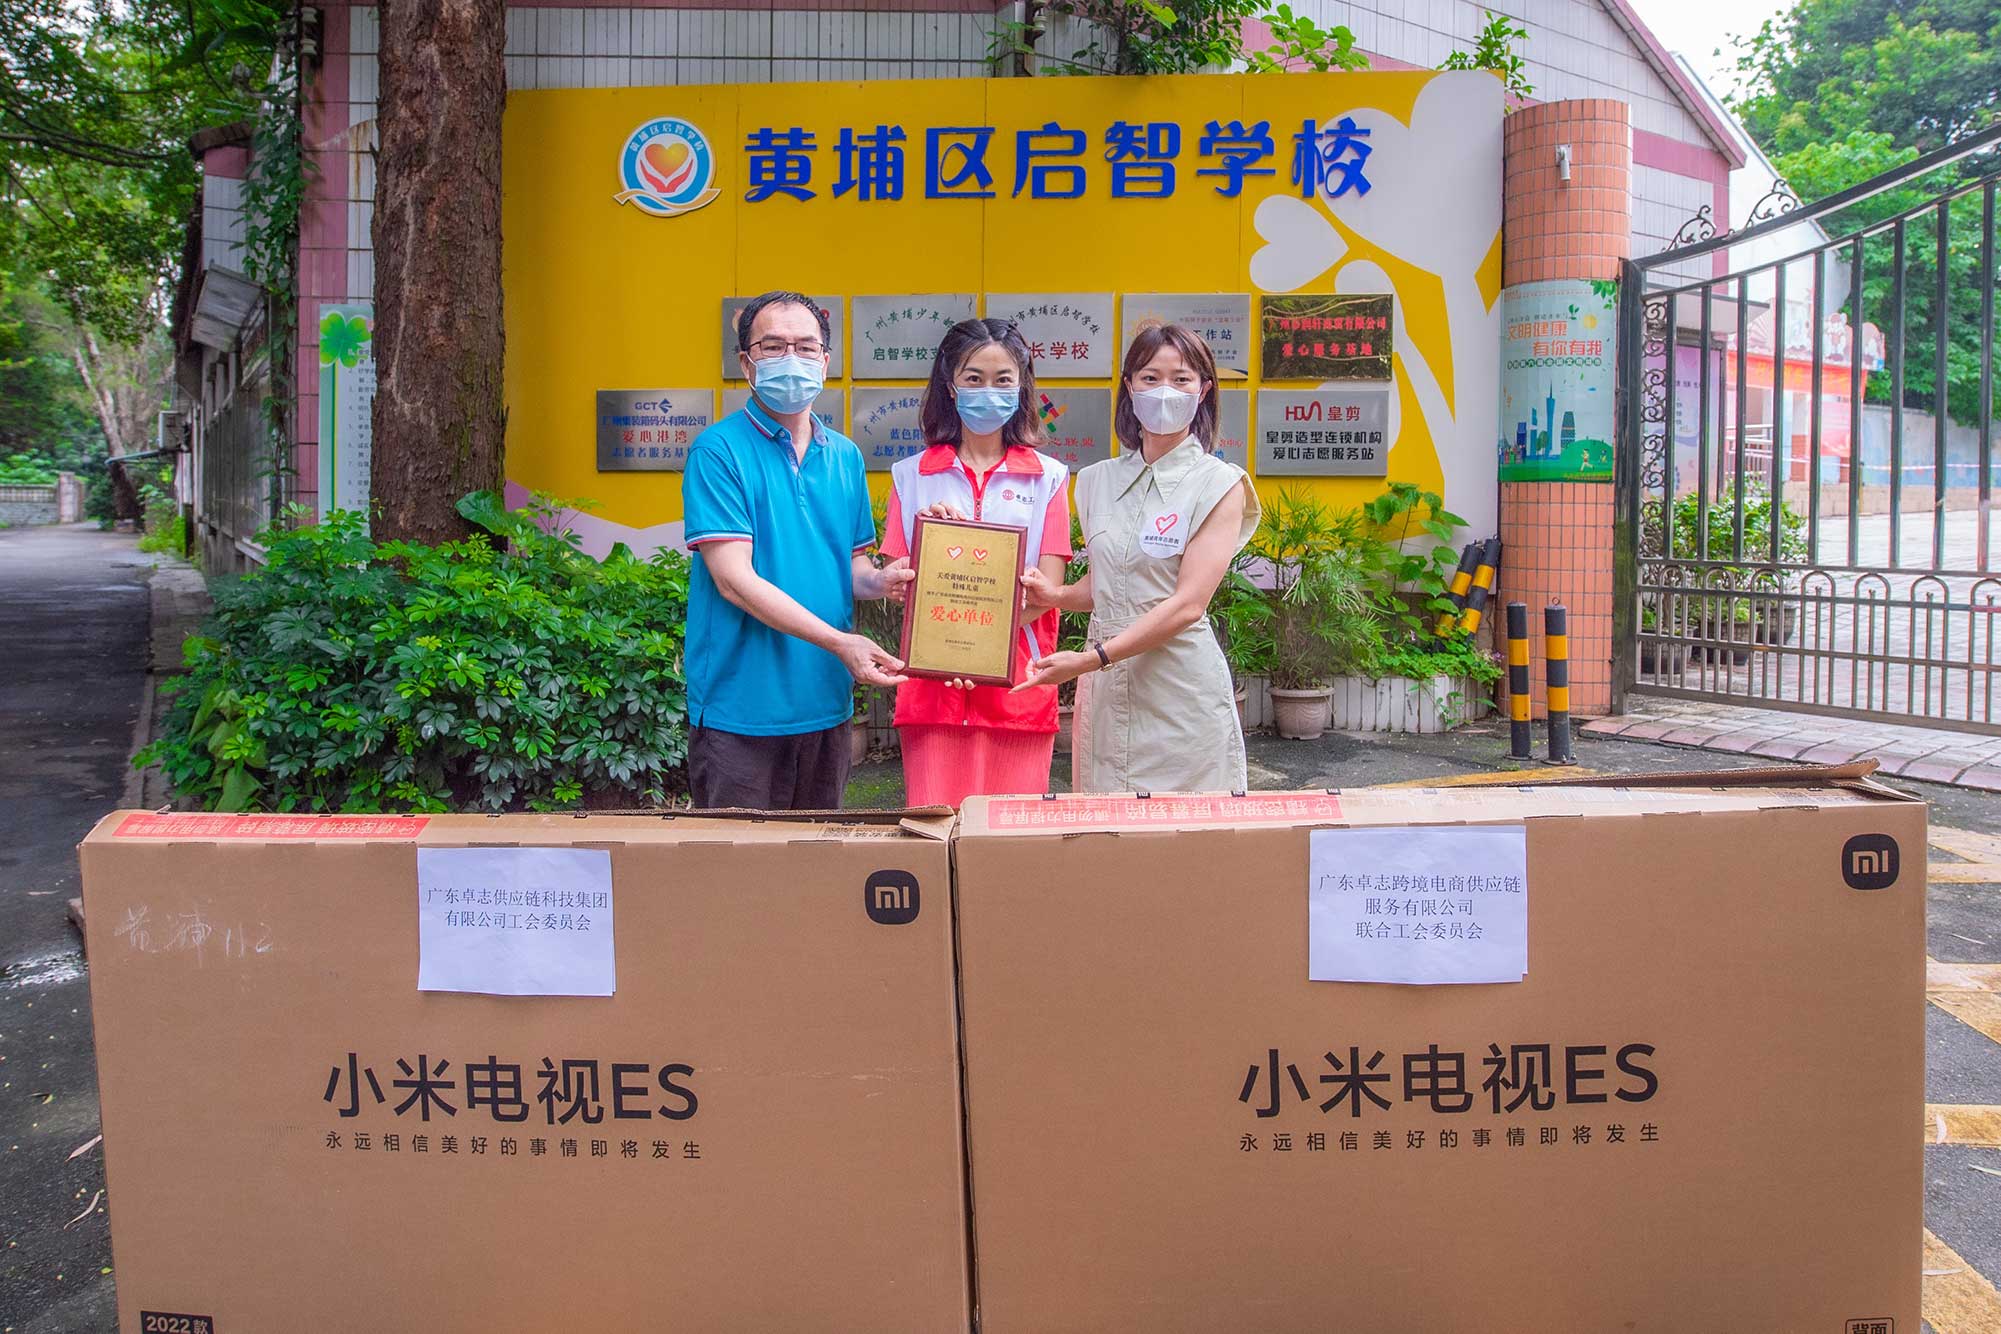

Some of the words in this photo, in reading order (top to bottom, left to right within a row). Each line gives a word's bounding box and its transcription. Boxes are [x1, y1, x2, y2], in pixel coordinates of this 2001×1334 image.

[745, 118, 1374, 202] 黄埔区启智学校
[1509, 320, 1567, 340] 文明健康
[1029, 341, 1089, 360] 长学校
[1533, 340, 1602, 357] 有你有我
[635, 402, 658, 410] GCT
[1328, 406, 1361, 421] 皇剪
[623, 430, 688, 443] 爱心港湾
[1266, 431, 1382, 444] 皇剪造型连锁机构
[612, 447, 690, 458] 志愿者服务基
[1273, 447, 1374, 460] 爱心志愿服务站
[930, 605, 993, 626] 爱心单位
[1219, 800, 1308, 818] 精密玻璃
[1319, 873, 1521, 893] 广东卓志跨境电商供应链
[427, 888, 608, 909] 广东卓志供应链科技集团
[1364, 897, 1474, 917] 服务有限公司
[444, 910, 592, 931] 有限公司工会委员会
[1355, 921, 1483, 940] 联合工会委员会
[323, 1053, 699, 1125] 小米电视ES
[1238, 1043, 1659, 1118] 小米电视ES
[325, 1131, 701, 1160] 永远相信美好的事情即将发生
[1239, 1123, 1660, 1152] 永远相信美好的事情即将发生
